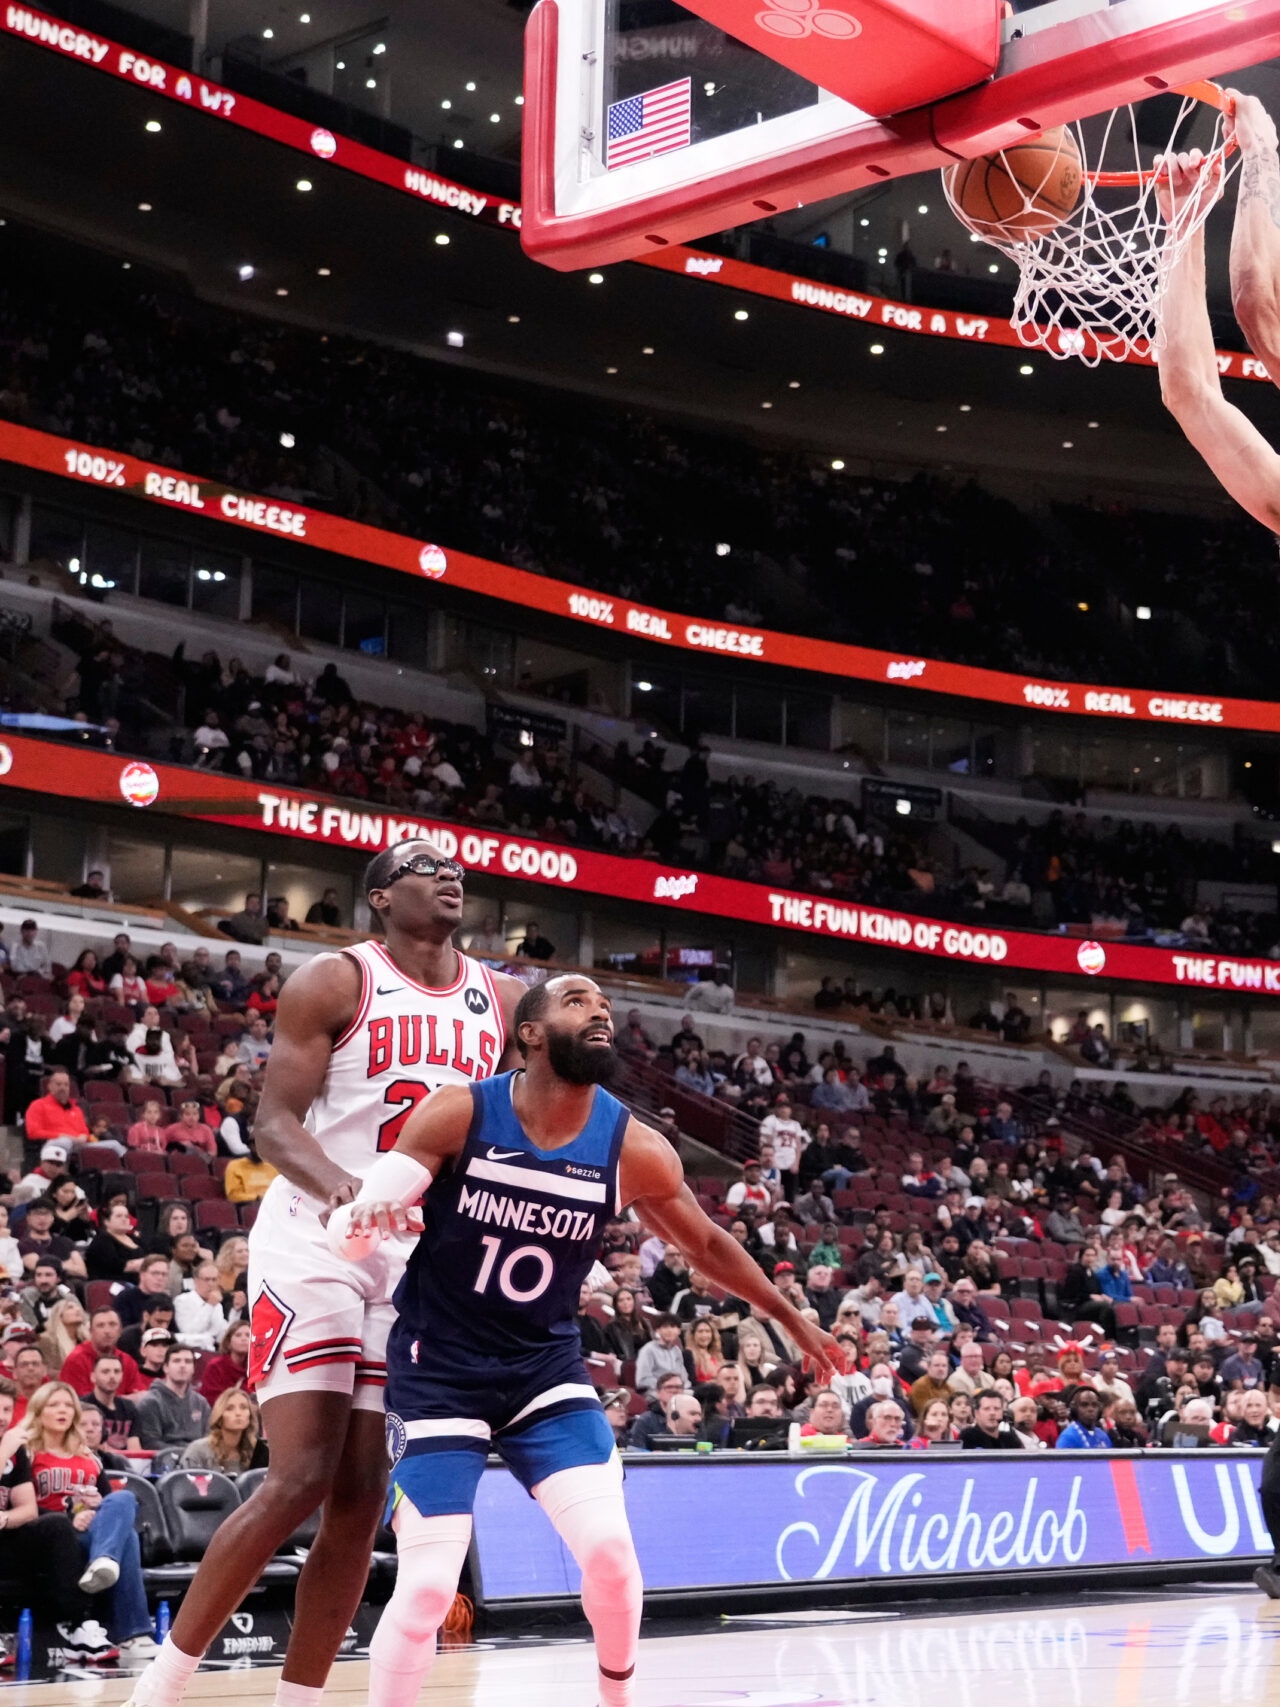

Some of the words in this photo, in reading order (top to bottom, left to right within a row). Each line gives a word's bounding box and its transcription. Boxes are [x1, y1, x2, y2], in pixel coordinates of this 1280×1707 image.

[7, 5, 109, 63] HUNGRY
[118, 52, 166, 89] FOR
[176, 75, 192, 99] A
[201, 84, 236, 116] W?
[404, 169, 487, 216] HUNGRY
[498, 204, 521, 228] FO
[792, 282, 872, 318] HUNGRY
[882, 304, 922, 331] FOR
[930, 314, 946, 333] A
[956, 317, 989, 339] W?
[1243, 358, 1272, 380] FO
[64, 449, 126, 487] 100%
[144, 472, 205, 510] REAL
[220, 494, 307, 537] CHEESE
[568, 593, 615, 624] 100%
[626, 610, 672, 640] REAL
[685, 625, 764, 656] CHEESE
[1023, 684, 1070, 707] 100%
[1084, 692, 1136, 715] REAL
[1149, 697, 1223, 723] CHEESE
[258, 794, 318, 834] THE
[321, 807, 382, 847] FUN
[461, 835, 499, 867] OF
[502, 843, 577, 882] GOOD
[769, 893, 812, 928] THE
[814, 903, 858, 935] FUN
[860, 913, 912, 945] KIND
[914, 923, 942, 950] OF
[944, 928, 1007, 961] GOOD
[1172, 956, 1216, 984] THE
[1218, 960, 1262, 988] FUN
[366, 1014, 497, 1082] BULLS
[376, 1079, 432, 1153] 2
[571, 1166, 601, 1179] sezzle
[456, 1184, 597, 1241] MINNESOTA
[473, 1235, 554, 1303] 10
[776, 1465, 1088, 1582] Michelob
